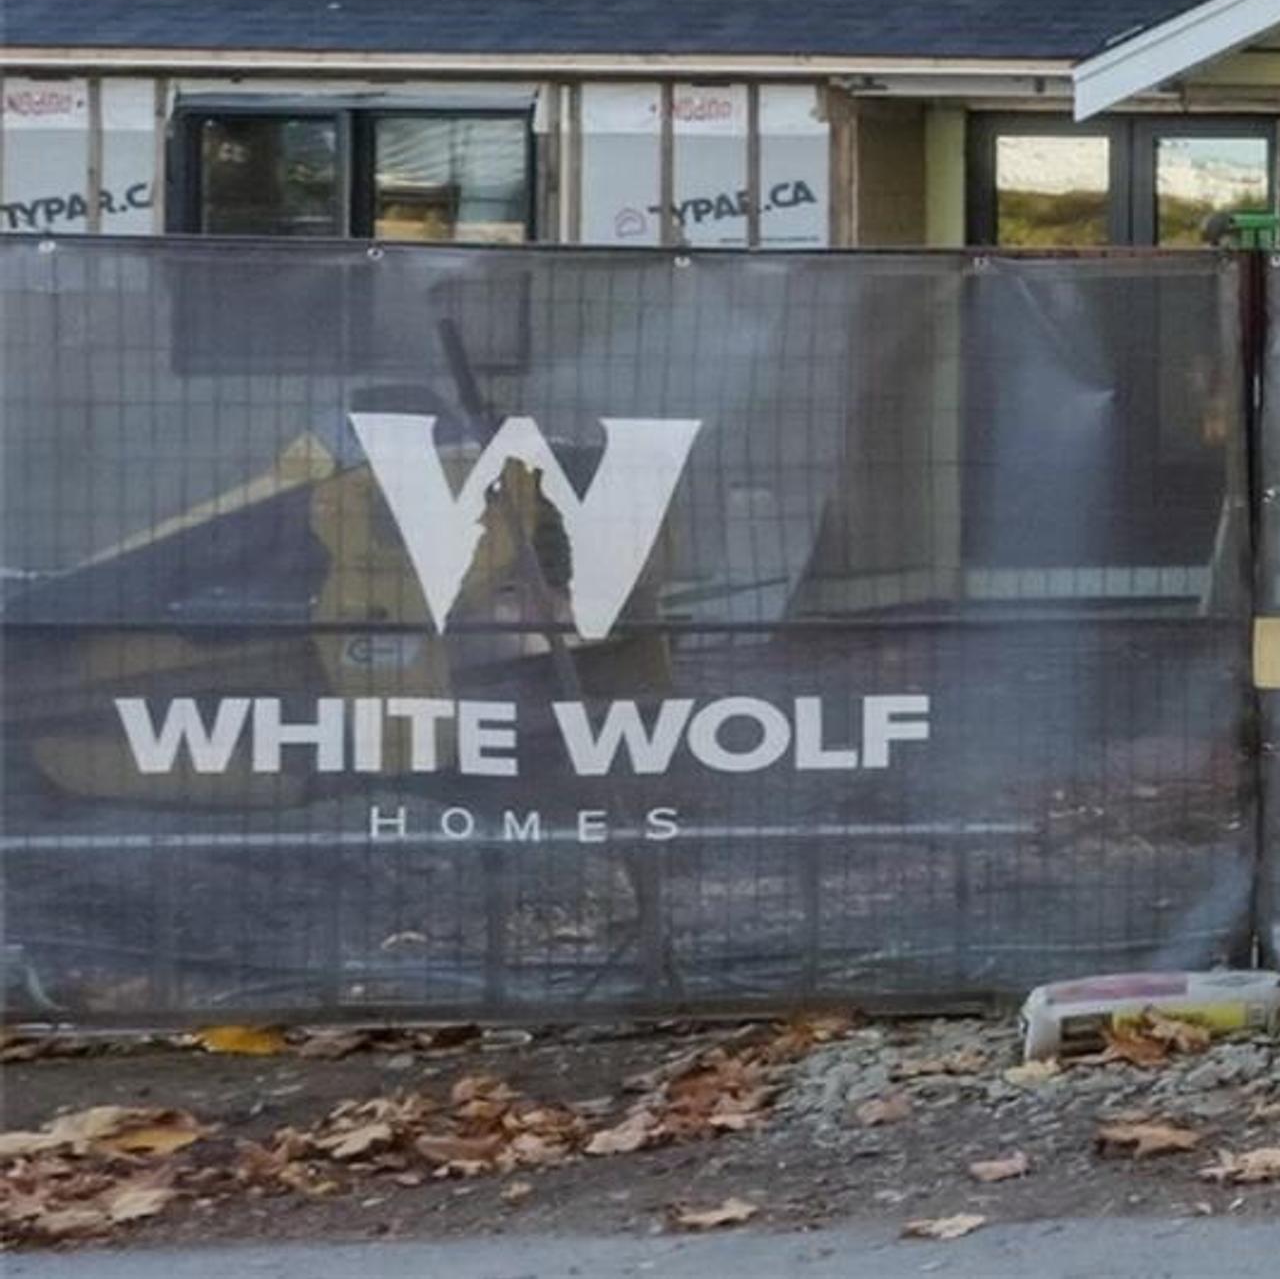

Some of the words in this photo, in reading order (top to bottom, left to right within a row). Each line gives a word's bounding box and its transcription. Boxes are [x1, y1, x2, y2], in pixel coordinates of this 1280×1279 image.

[115, 696, 518, 776] WHITE
[552, 694, 930, 776] WOLF
[370, 805, 681, 843] HOMES
